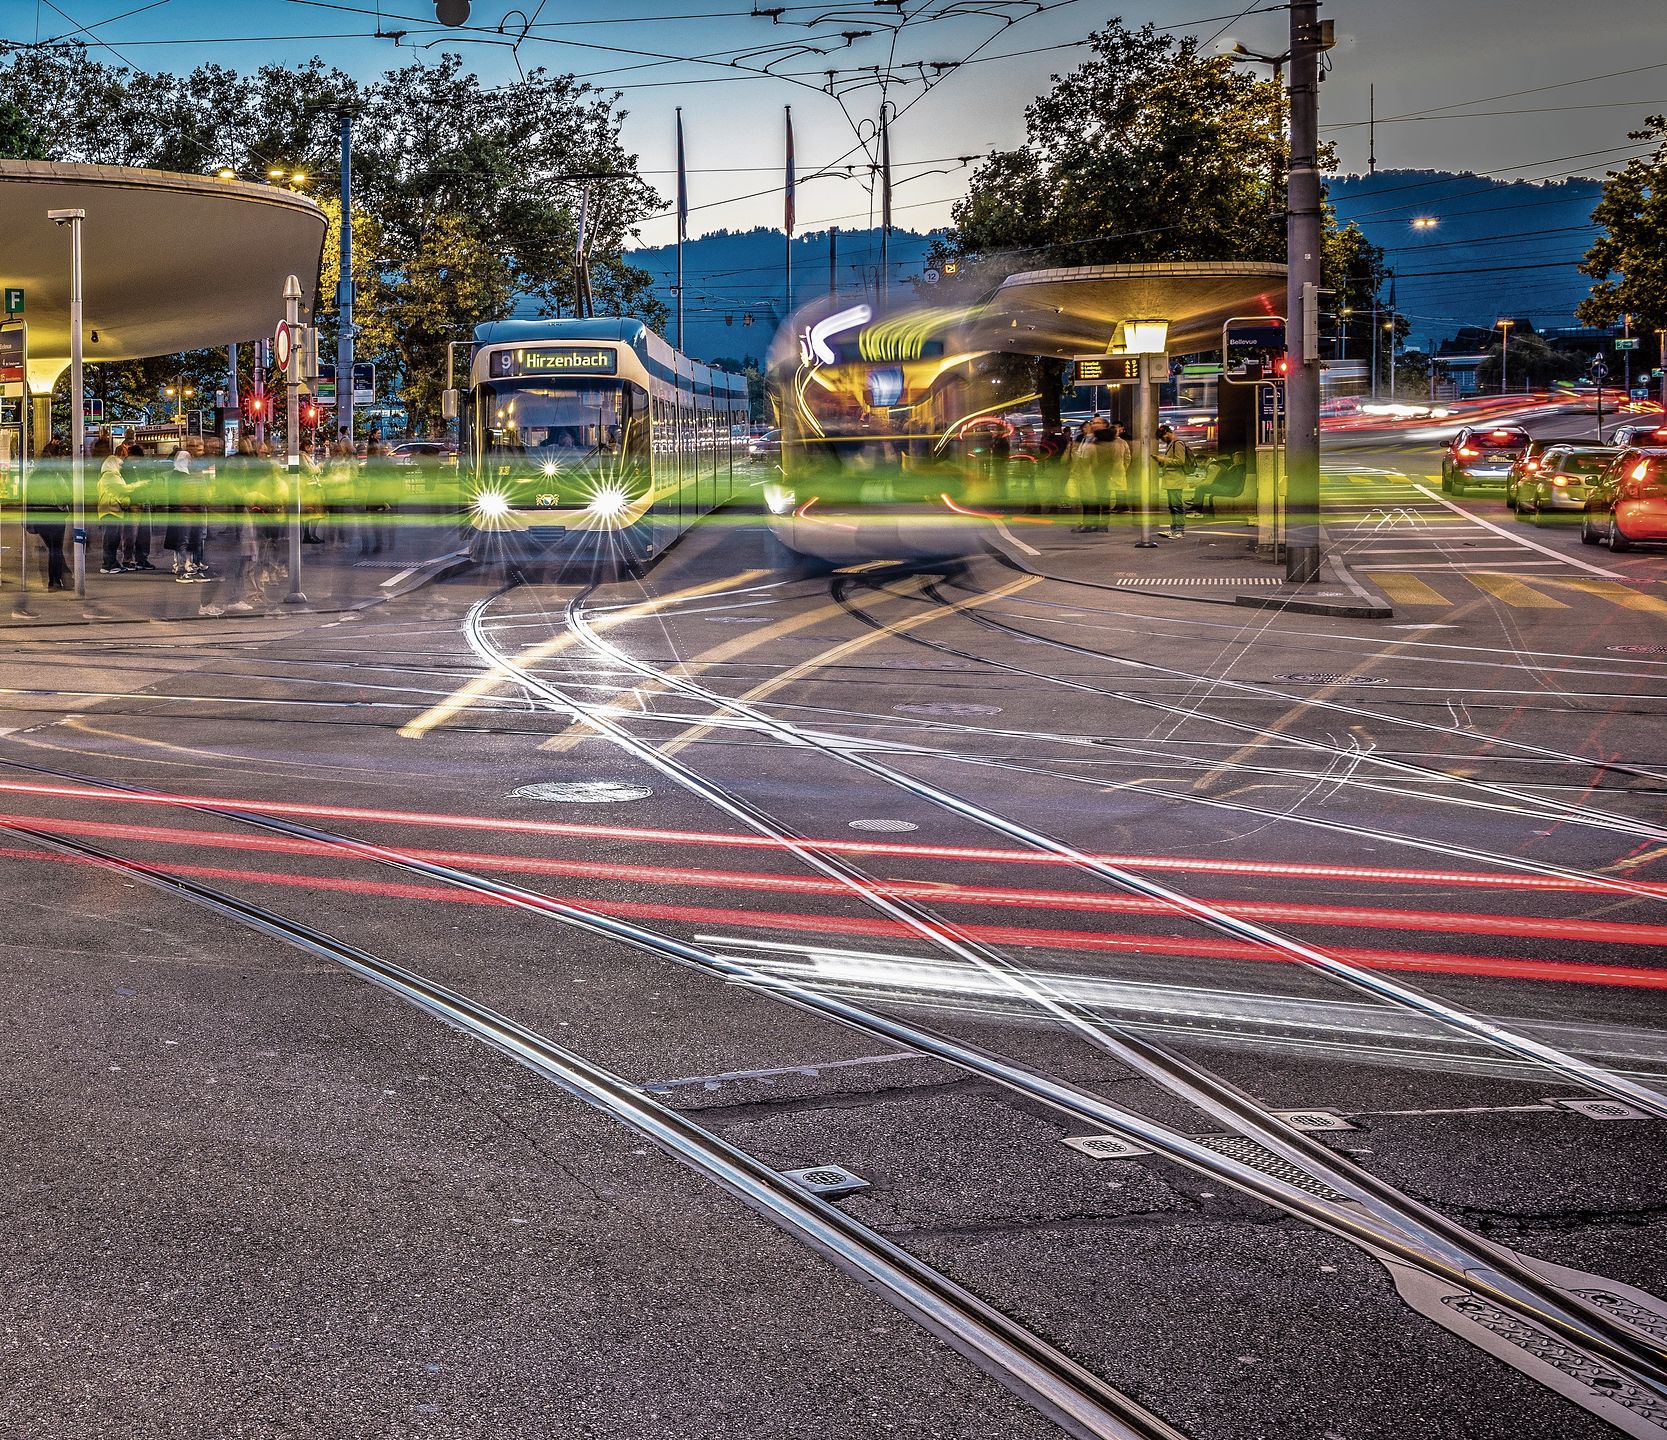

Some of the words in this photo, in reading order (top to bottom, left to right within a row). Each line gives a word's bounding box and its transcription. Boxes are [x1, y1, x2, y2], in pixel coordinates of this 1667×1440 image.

[928, 272, 936, 281] 12
[10, 291, 20, 309] F
[501, 355, 511, 369] 9
[526, 352, 608, 368] Hirzenbach
